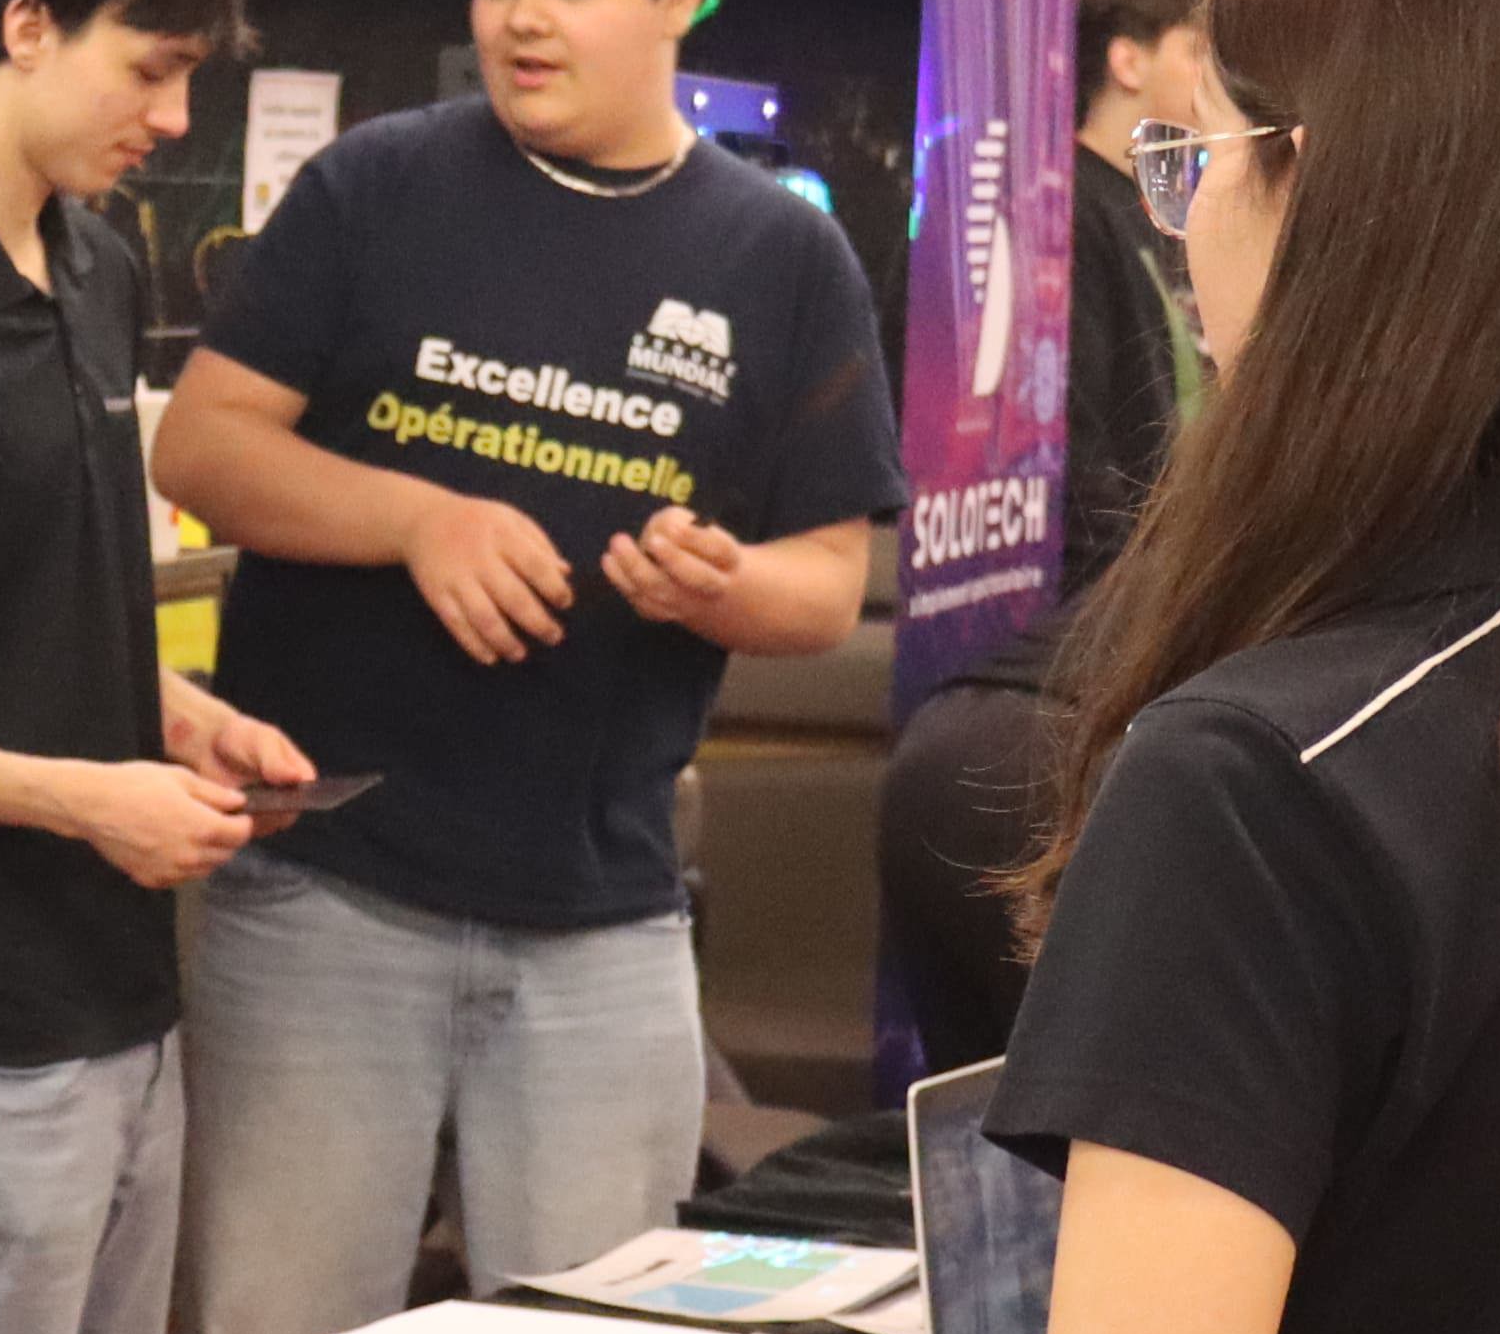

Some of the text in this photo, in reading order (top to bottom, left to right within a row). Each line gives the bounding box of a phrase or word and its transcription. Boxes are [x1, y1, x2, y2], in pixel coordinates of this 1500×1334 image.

[415, 337, 683, 437] Excellence
[627, 346, 730, 400] MUNDIAL
[366, 391, 695, 505] Opérationnelle
[911, 475, 1047, 569] SOLOTECH
